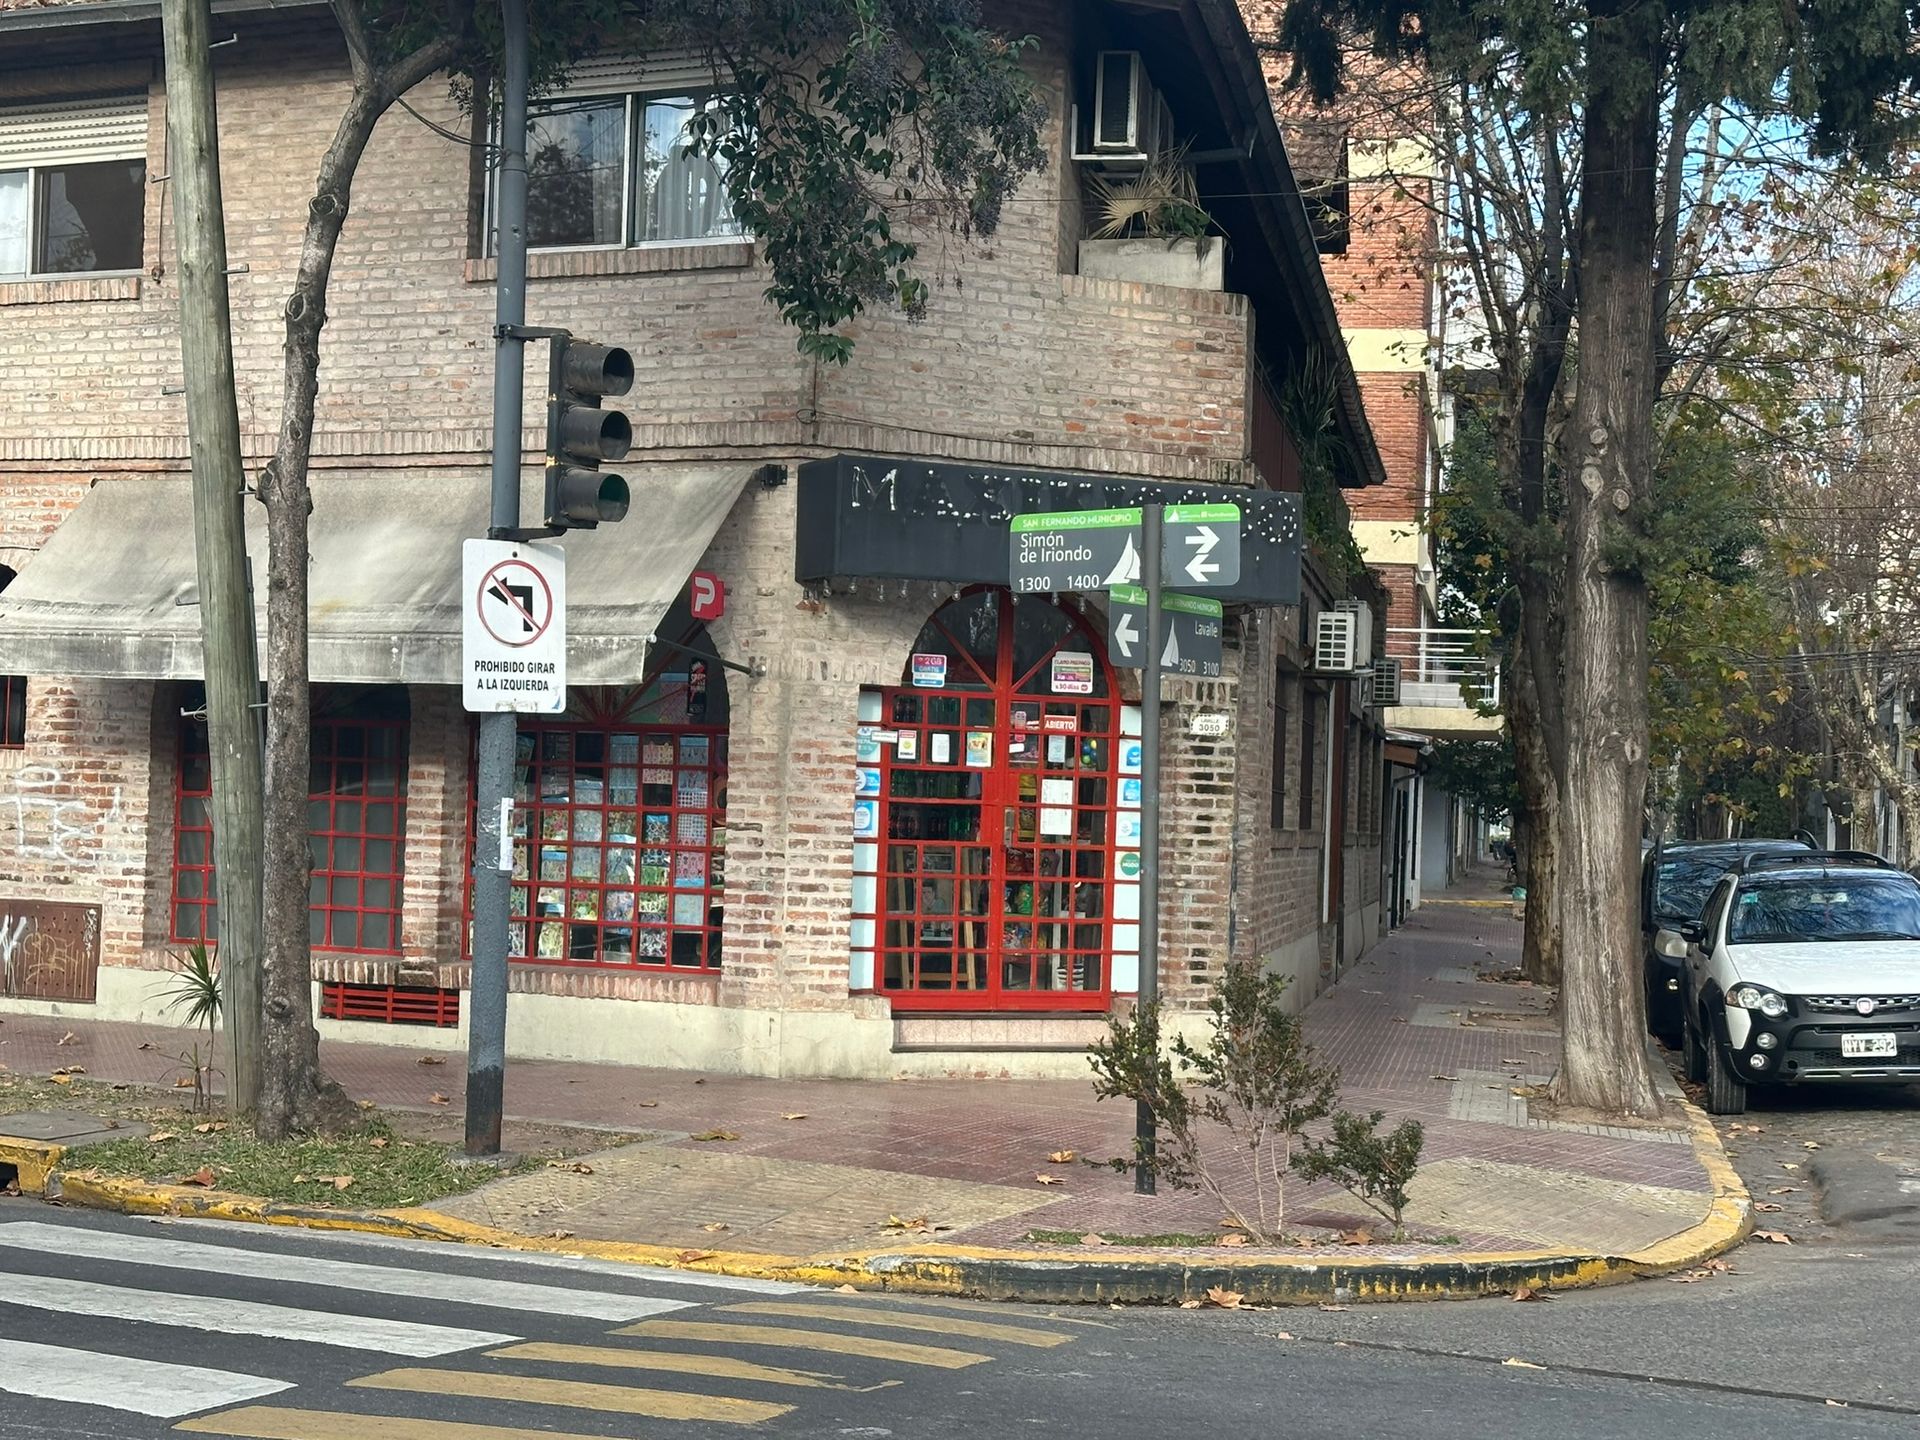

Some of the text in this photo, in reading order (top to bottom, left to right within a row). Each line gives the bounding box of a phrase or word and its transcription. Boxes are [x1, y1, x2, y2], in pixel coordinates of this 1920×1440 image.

[1022, 513, 1132, 528] SAN FERNANDO MUNICIPIO
[1020, 531, 1064, 548] Simón
[1019, 545, 1092, 563] de Iriondo
[1018, 574, 1099, 591] 1300 1400
[1194, 620, 1218, 638] Lavalle
[474, 660, 555, 674] PROHIBIDO GIRAR
[1179, 658, 1219, 676] 3050 3100
[477, 678, 549, 691] A LA IZQUIERDA
[1044, 720, 1074, 730] ABIERTO
[1198, 723, 1220, 732] 3050
[1872, 1038, 1895, 1052] 292
